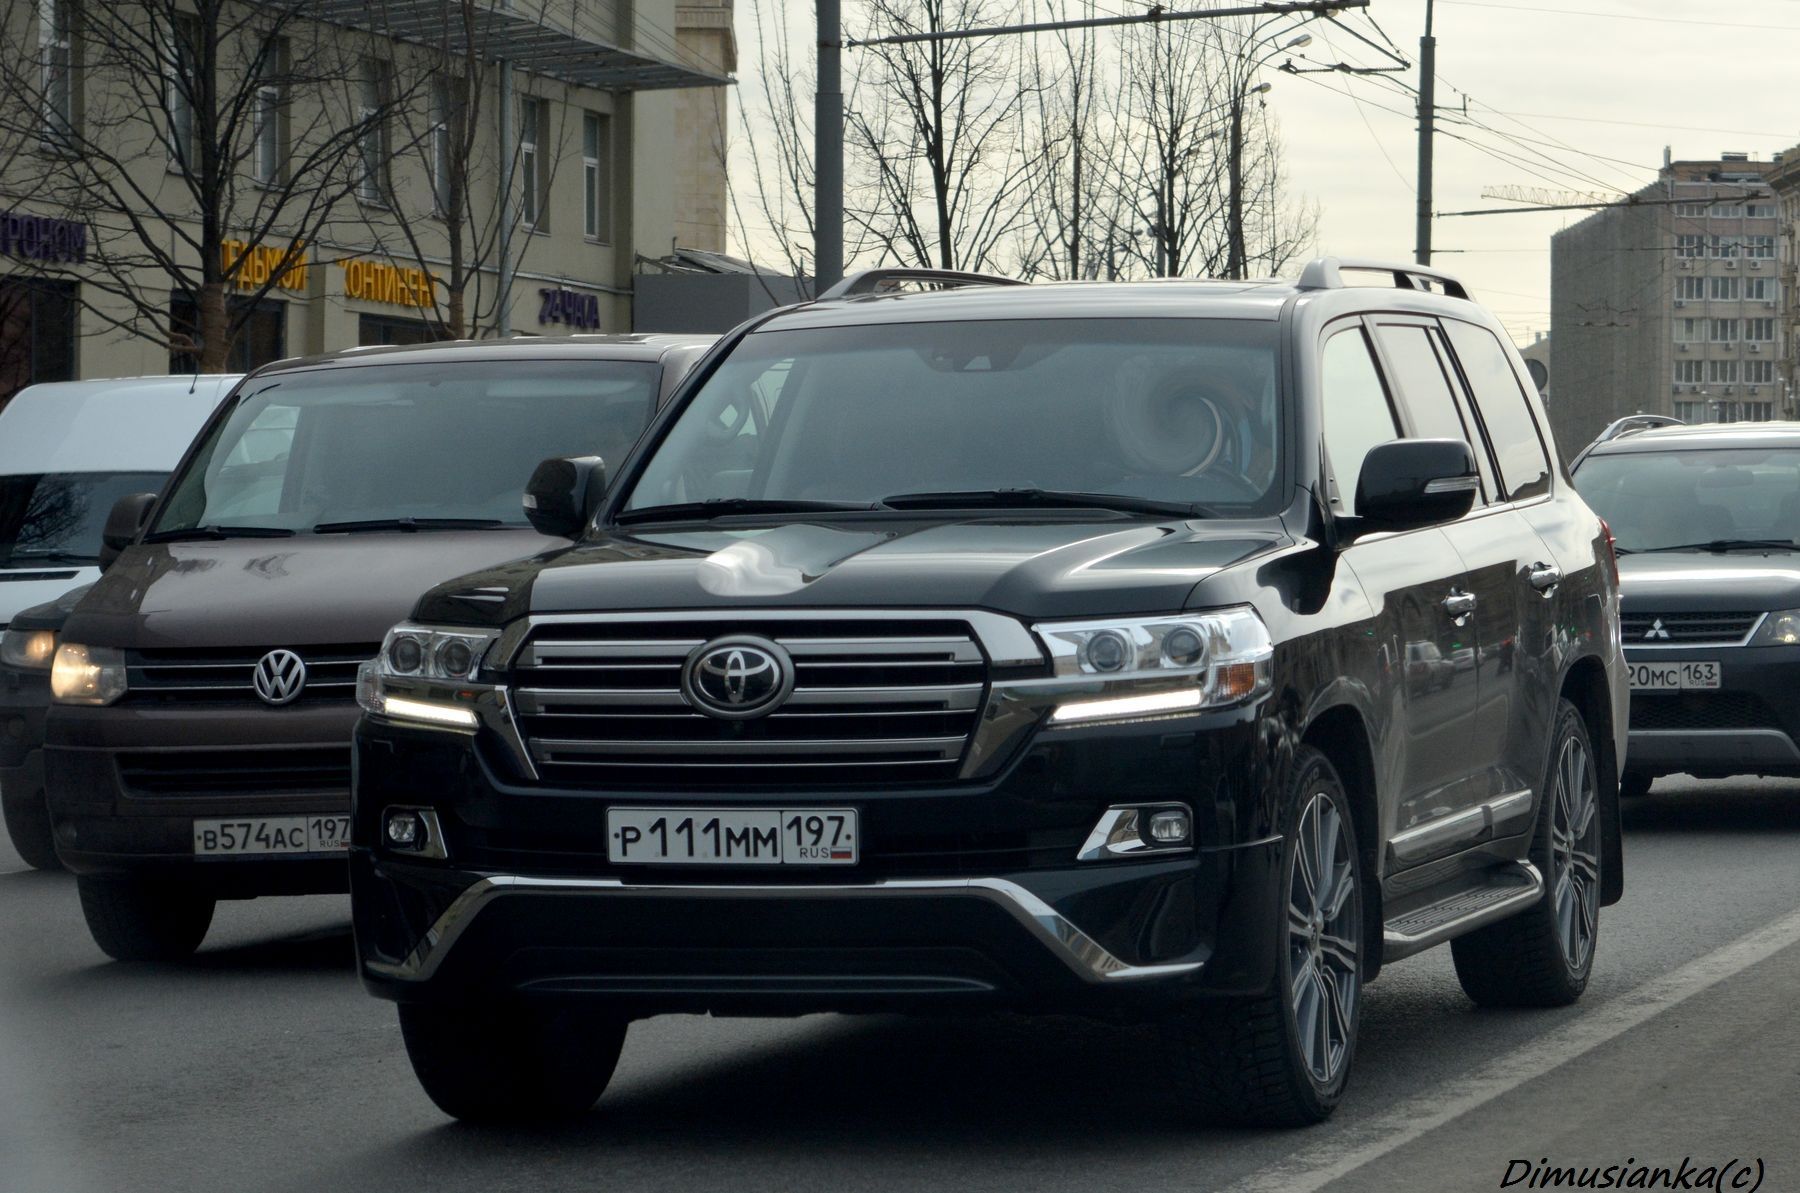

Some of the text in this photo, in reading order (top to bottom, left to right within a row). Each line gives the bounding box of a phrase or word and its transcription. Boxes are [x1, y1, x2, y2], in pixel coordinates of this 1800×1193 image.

[221, 239, 310, 291] ЕДЬМОЙ
[1682, 663, 1715, 681] 163
[203, 818, 350, 851] В574АС 197
[319, 840, 340, 848] RUS
[620, 815, 846, 858] Р111ММ 197
[799, 847, 829, 858] RUS
